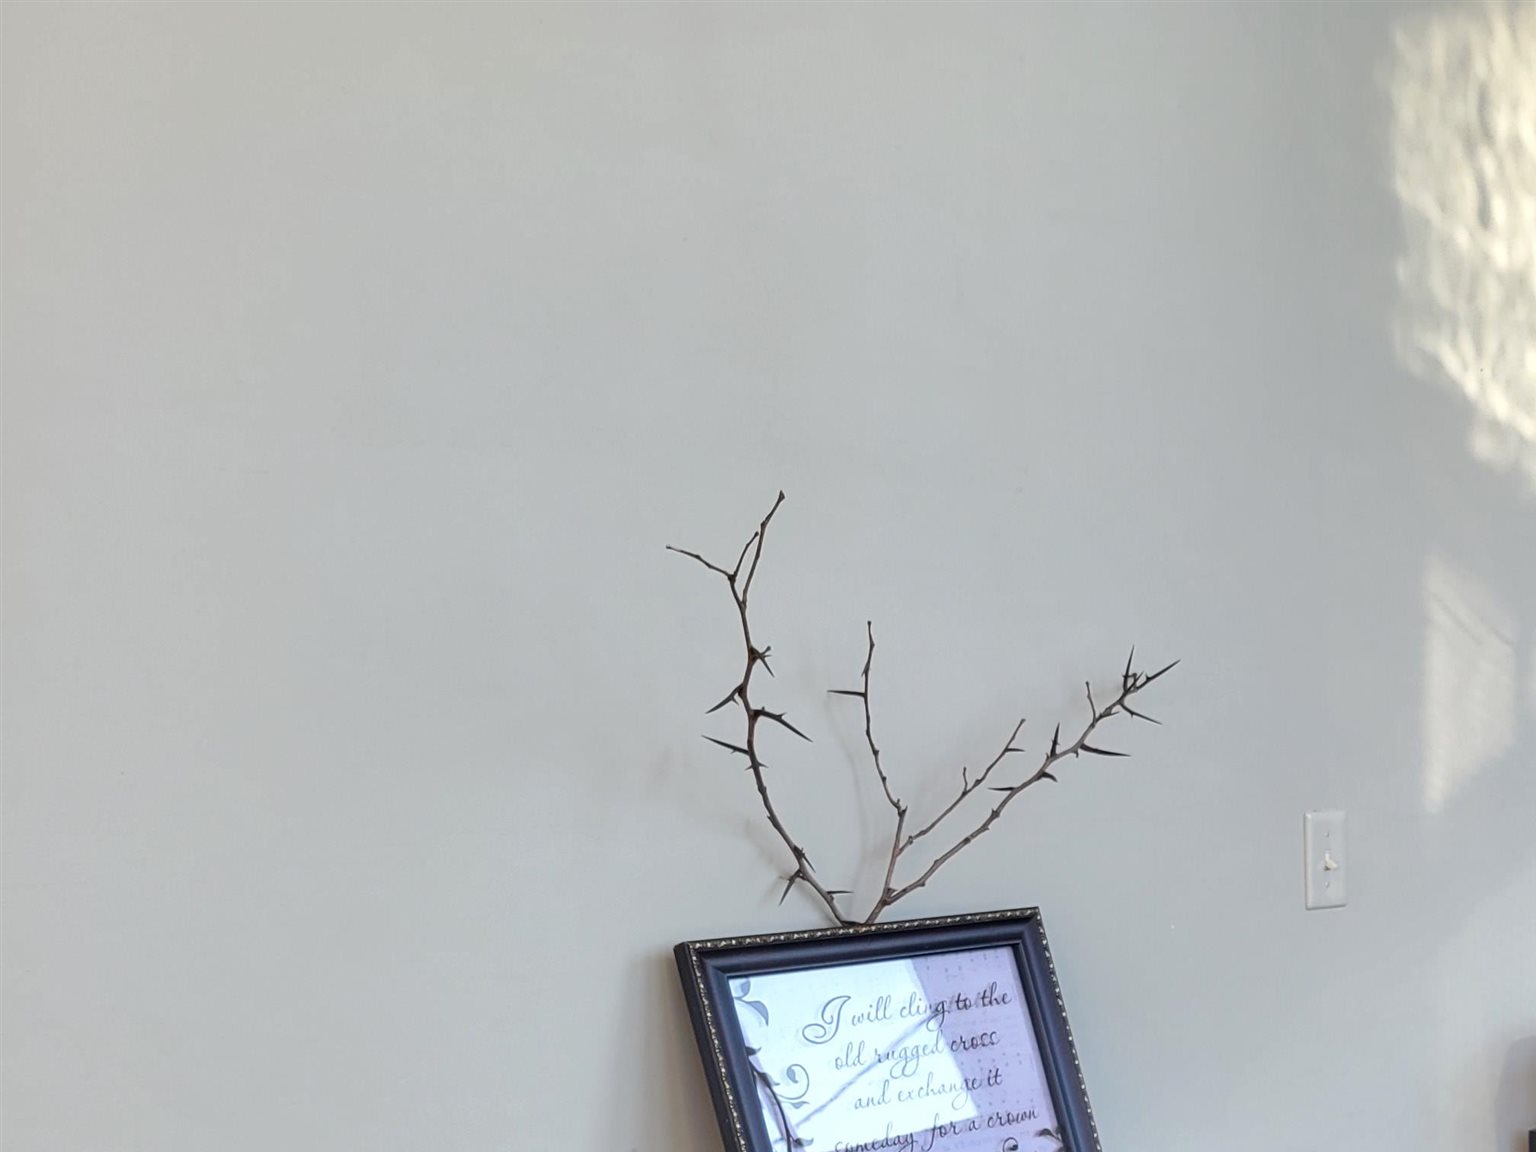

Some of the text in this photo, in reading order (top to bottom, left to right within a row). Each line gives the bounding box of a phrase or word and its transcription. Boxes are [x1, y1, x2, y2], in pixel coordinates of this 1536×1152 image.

[802, 981, 1012, 1044] I will cling to the
[835, 1029, 1000, 1078] old rugged cross
[854, 1067, 1003, 1111] and exchange it
[921, 1113, 960, 1152] for
[968, 1120, 980, 1132] a
[986, 1108, 1038, 1130] crown
